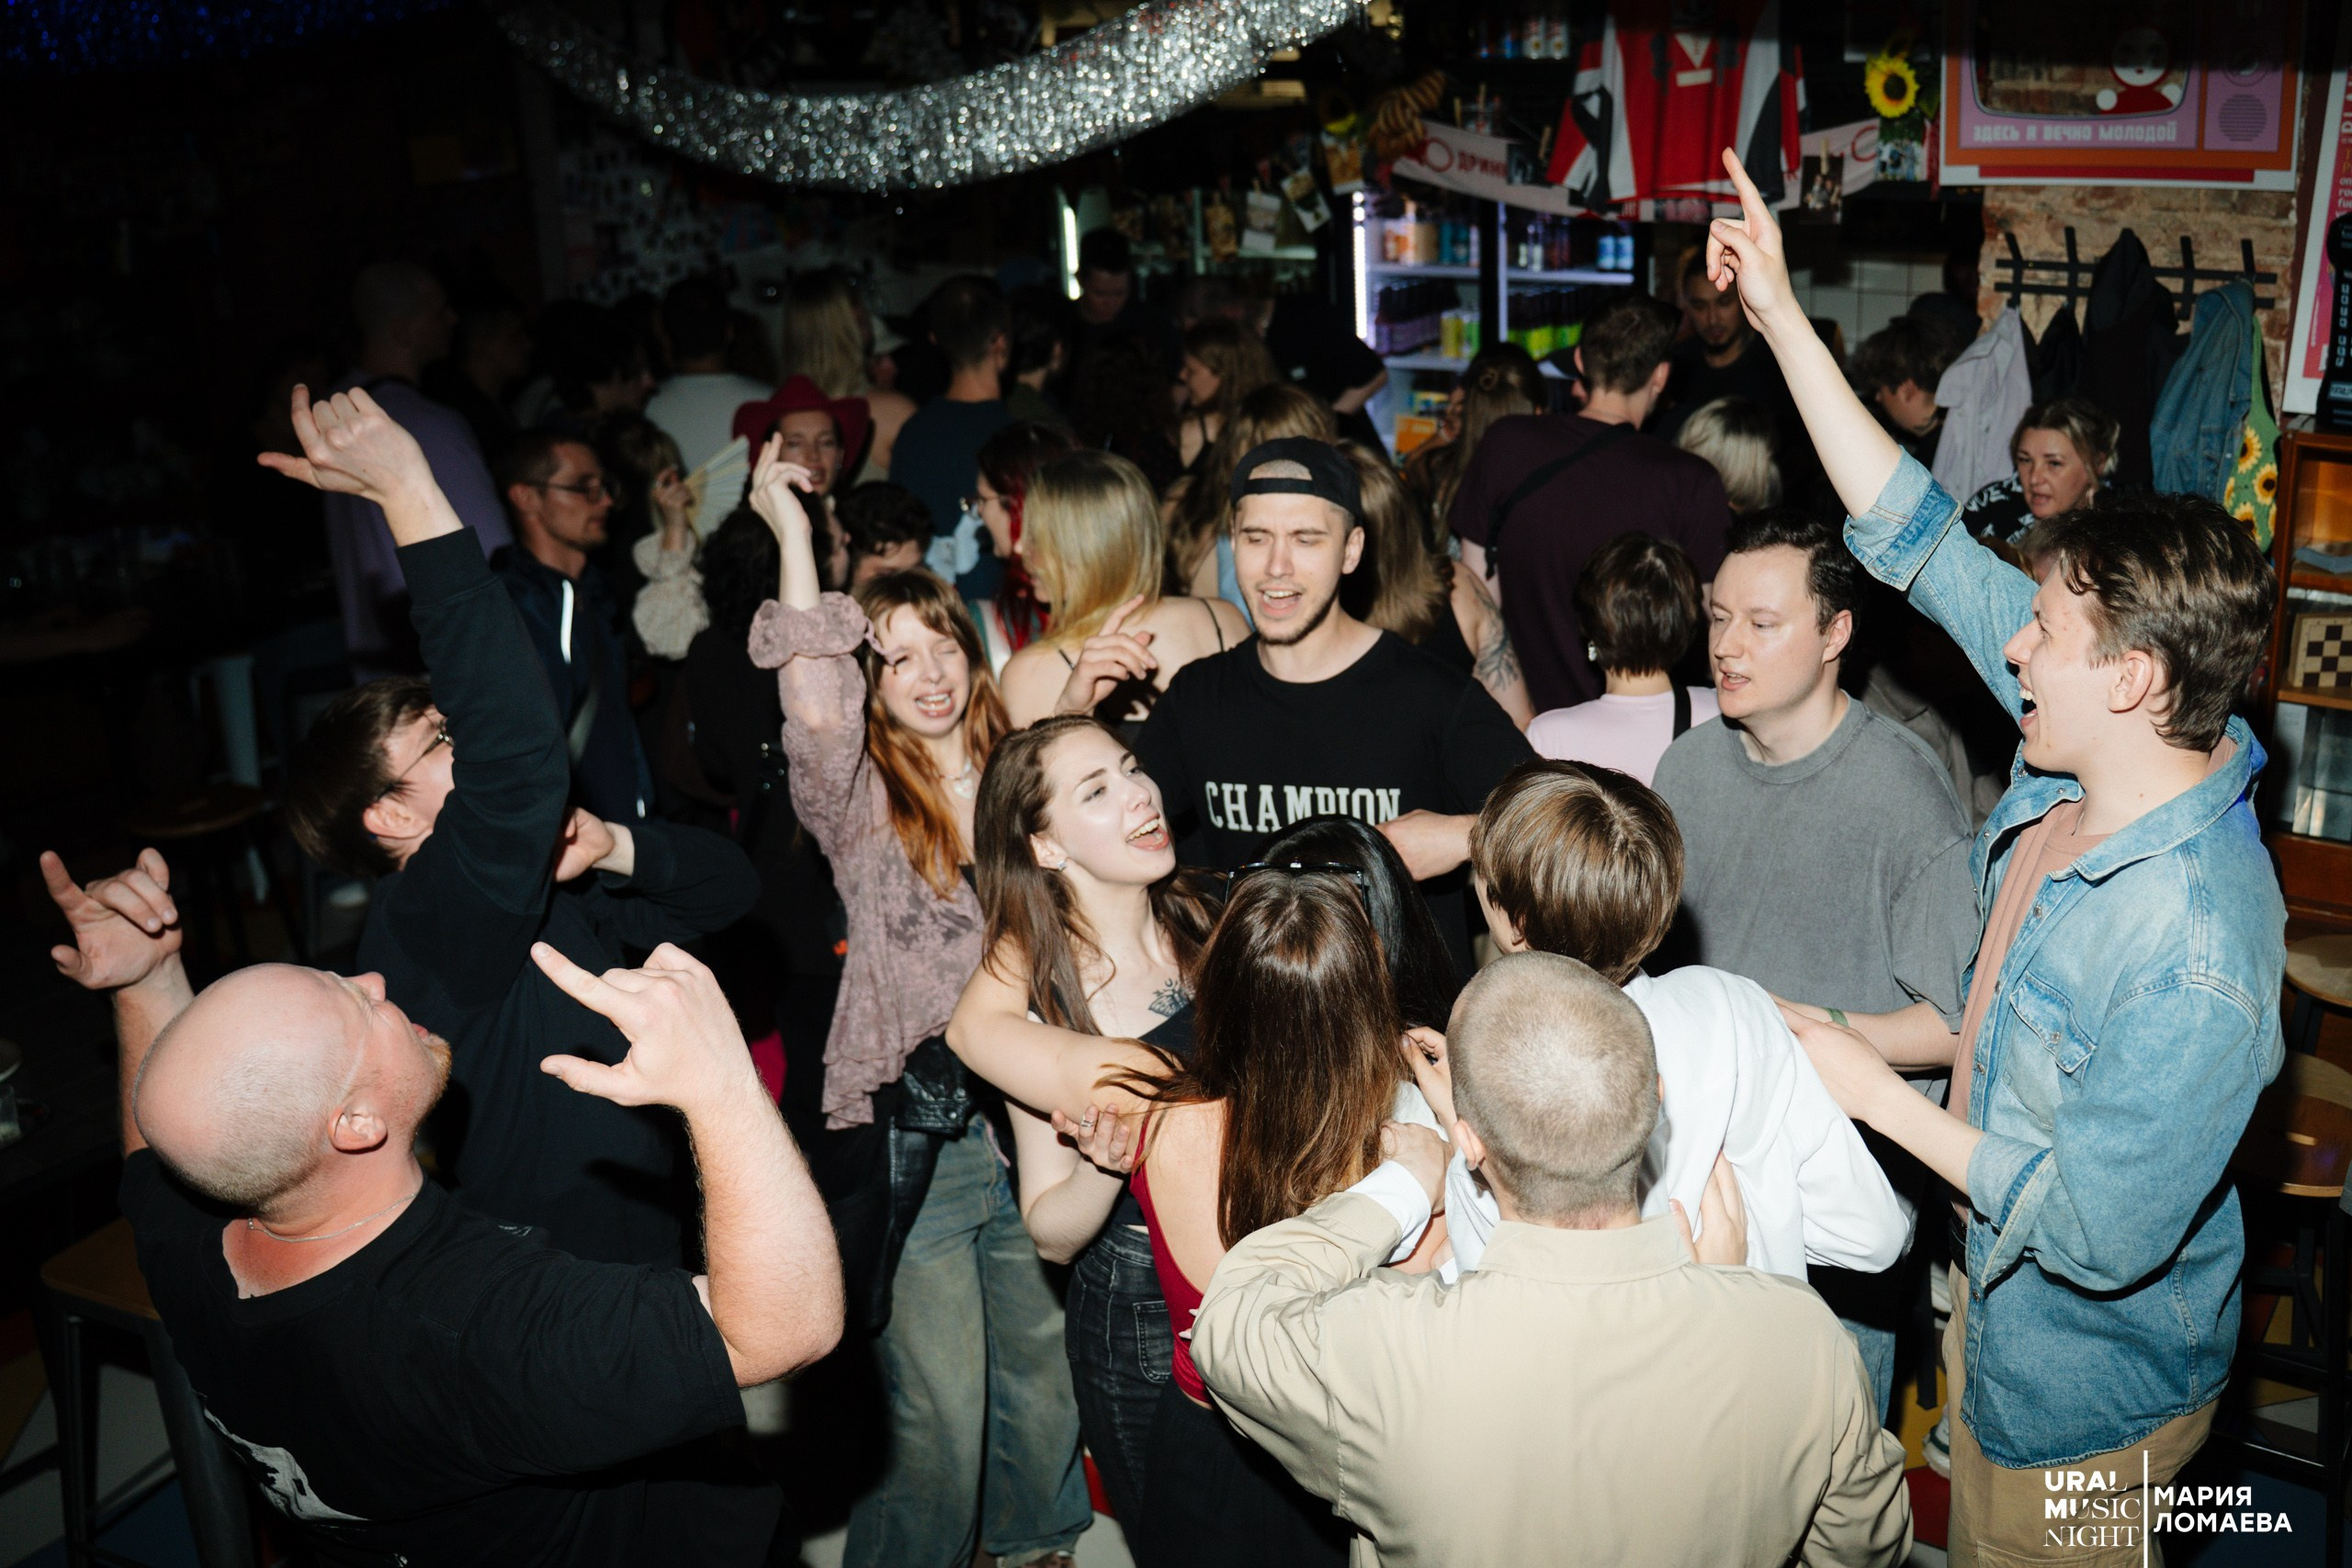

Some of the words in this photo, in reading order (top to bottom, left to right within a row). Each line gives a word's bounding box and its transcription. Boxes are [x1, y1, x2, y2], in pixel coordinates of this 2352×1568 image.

[1973, 124, 2019, 142] ЗДЕСЬ
[2026, 125, 2038, 141] Я
[2043, 125, 2092, 141] ВЕЧНО
[2098, 121, 2177, 142] МОЛОДОЙ
[1204, 781, 1401, 833] CHAMPION
